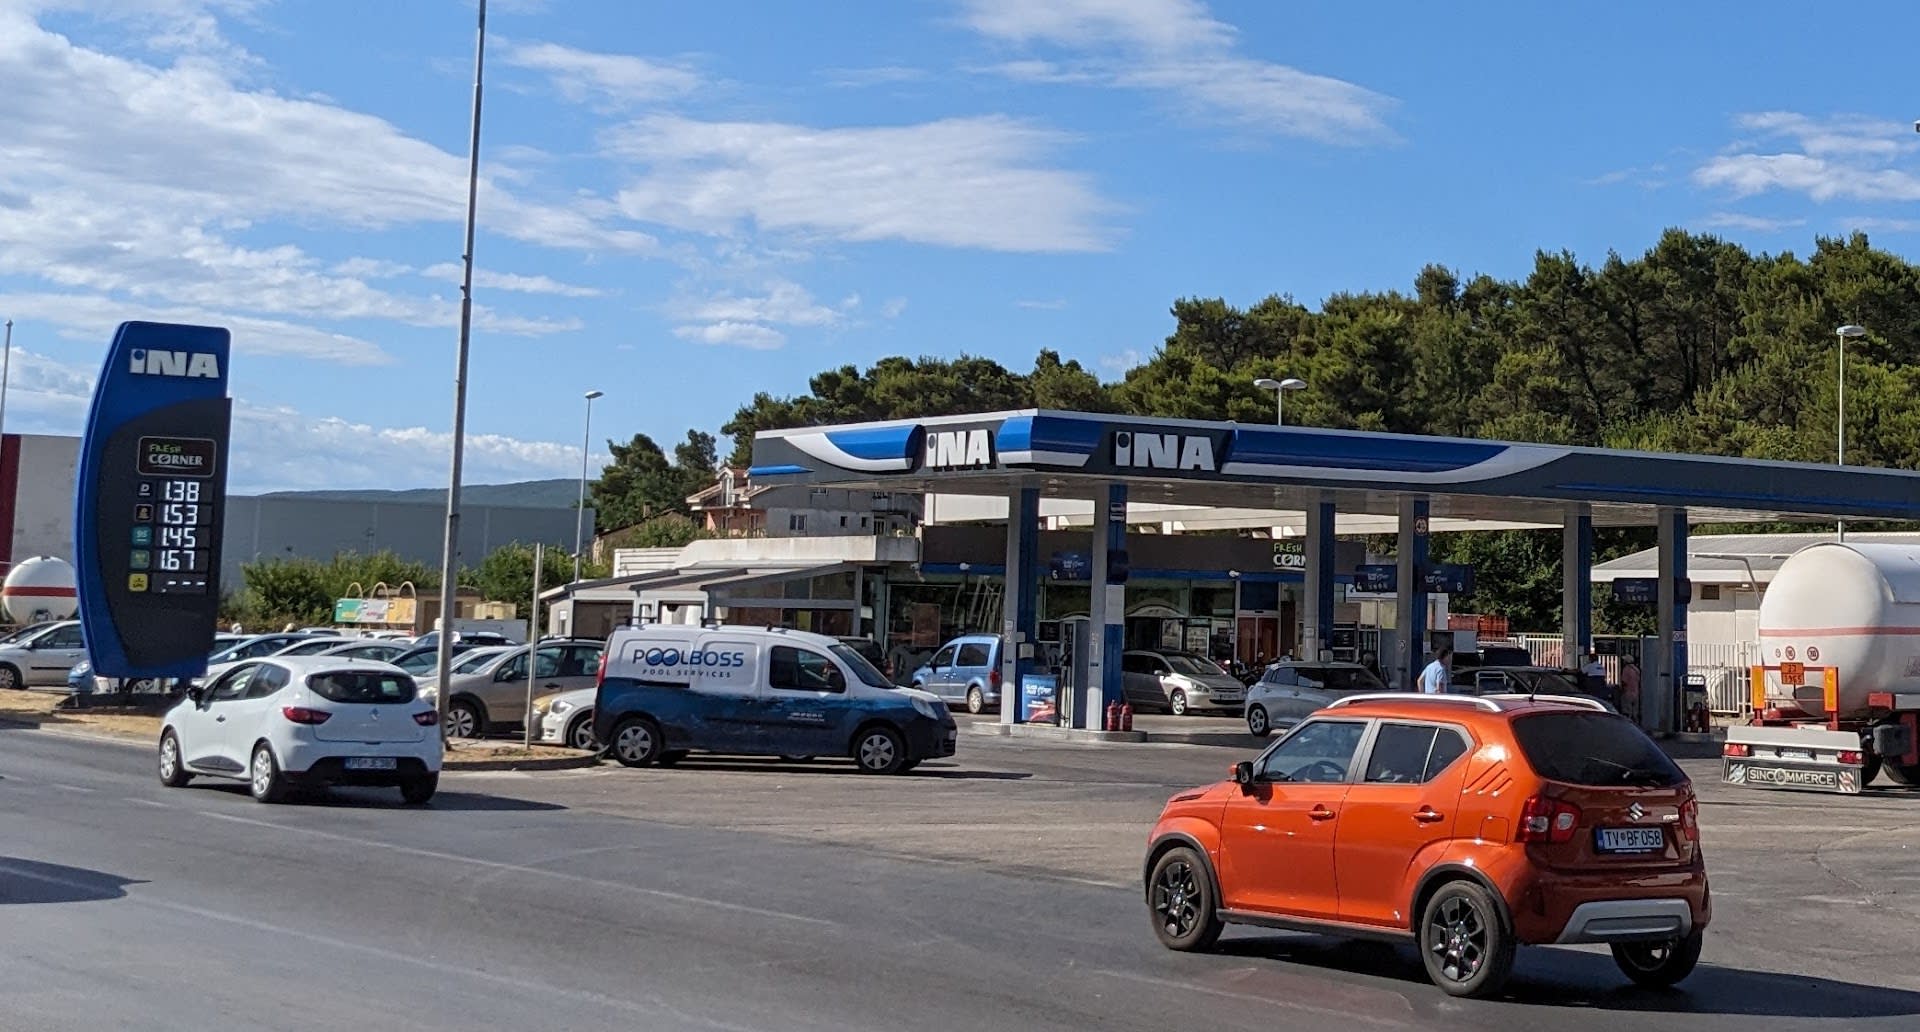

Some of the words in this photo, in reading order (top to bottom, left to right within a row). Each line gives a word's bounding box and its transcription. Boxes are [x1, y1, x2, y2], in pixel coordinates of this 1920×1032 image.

[149, 453, 203, 466] CORNER
[632, 647, 744, 667] POOLBOSS
[642, 668, 671, 676] POOL
[677, 669, 732, 678] SERVICES
[1605, 831, 1619, 846] TV
